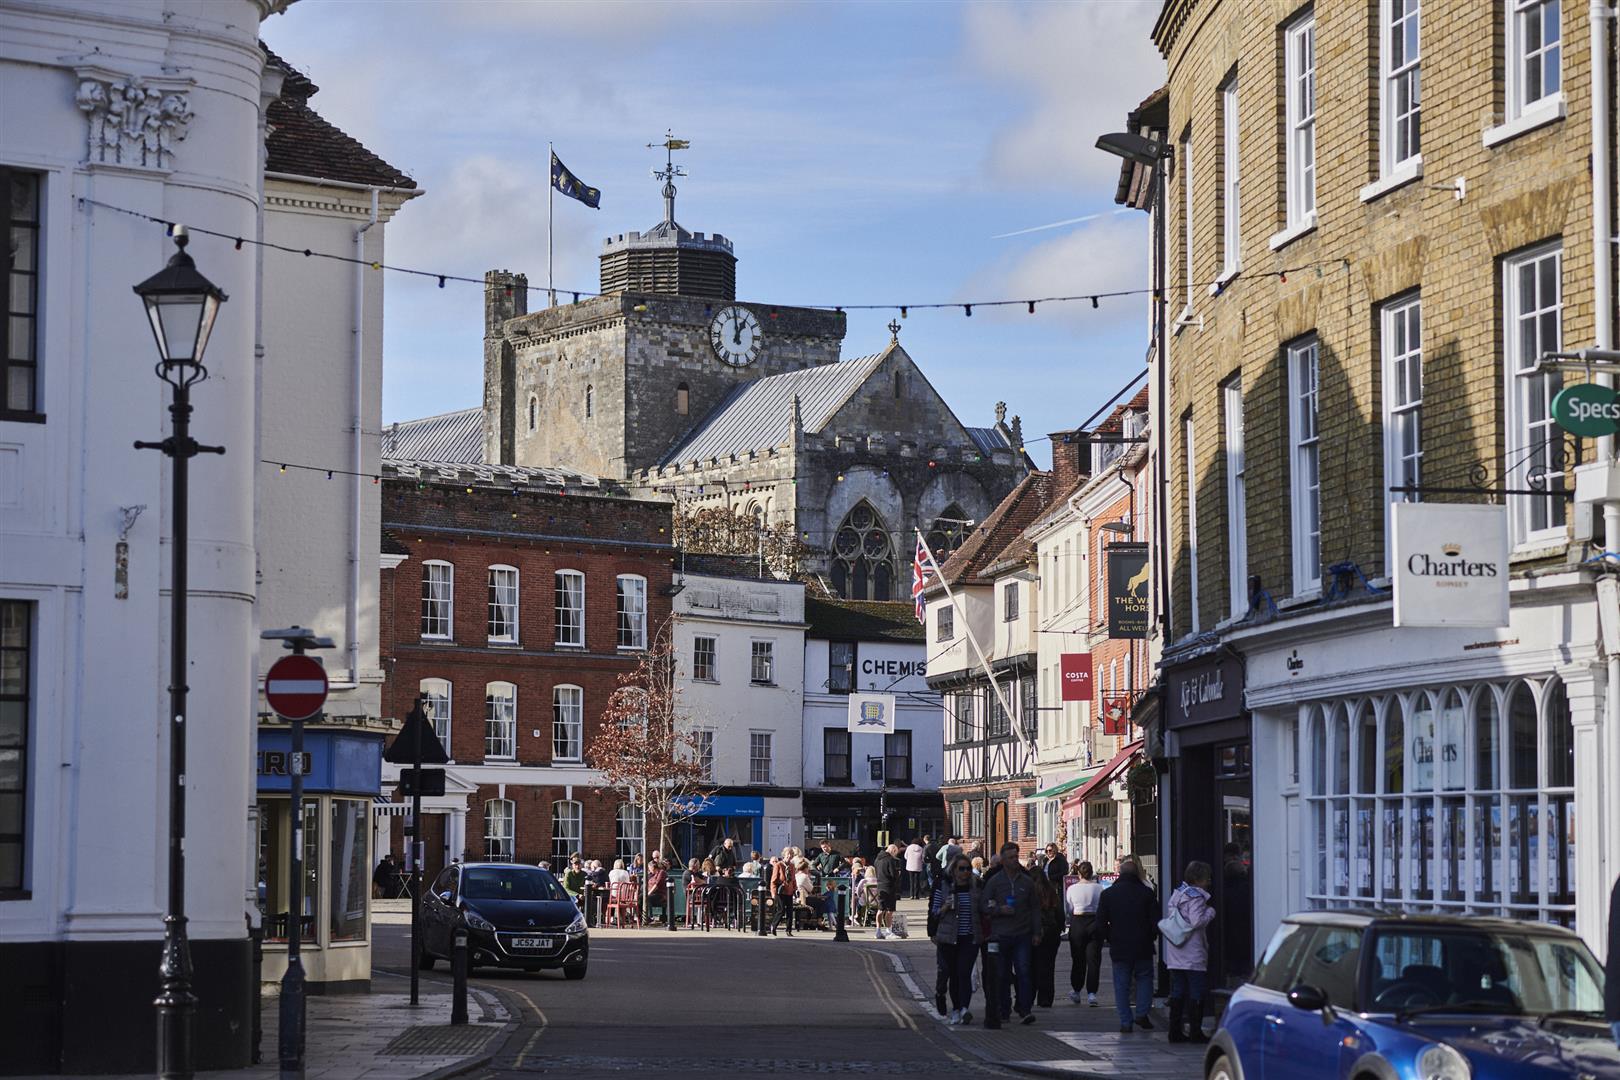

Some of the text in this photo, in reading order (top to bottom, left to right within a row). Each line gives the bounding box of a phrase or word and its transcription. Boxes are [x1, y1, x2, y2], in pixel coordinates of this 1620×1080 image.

[1568, 397, 1620, 422] Specs
[1408, 553, 1497, 577] Charters
[862, 660, 927, 676] CHEMIS
